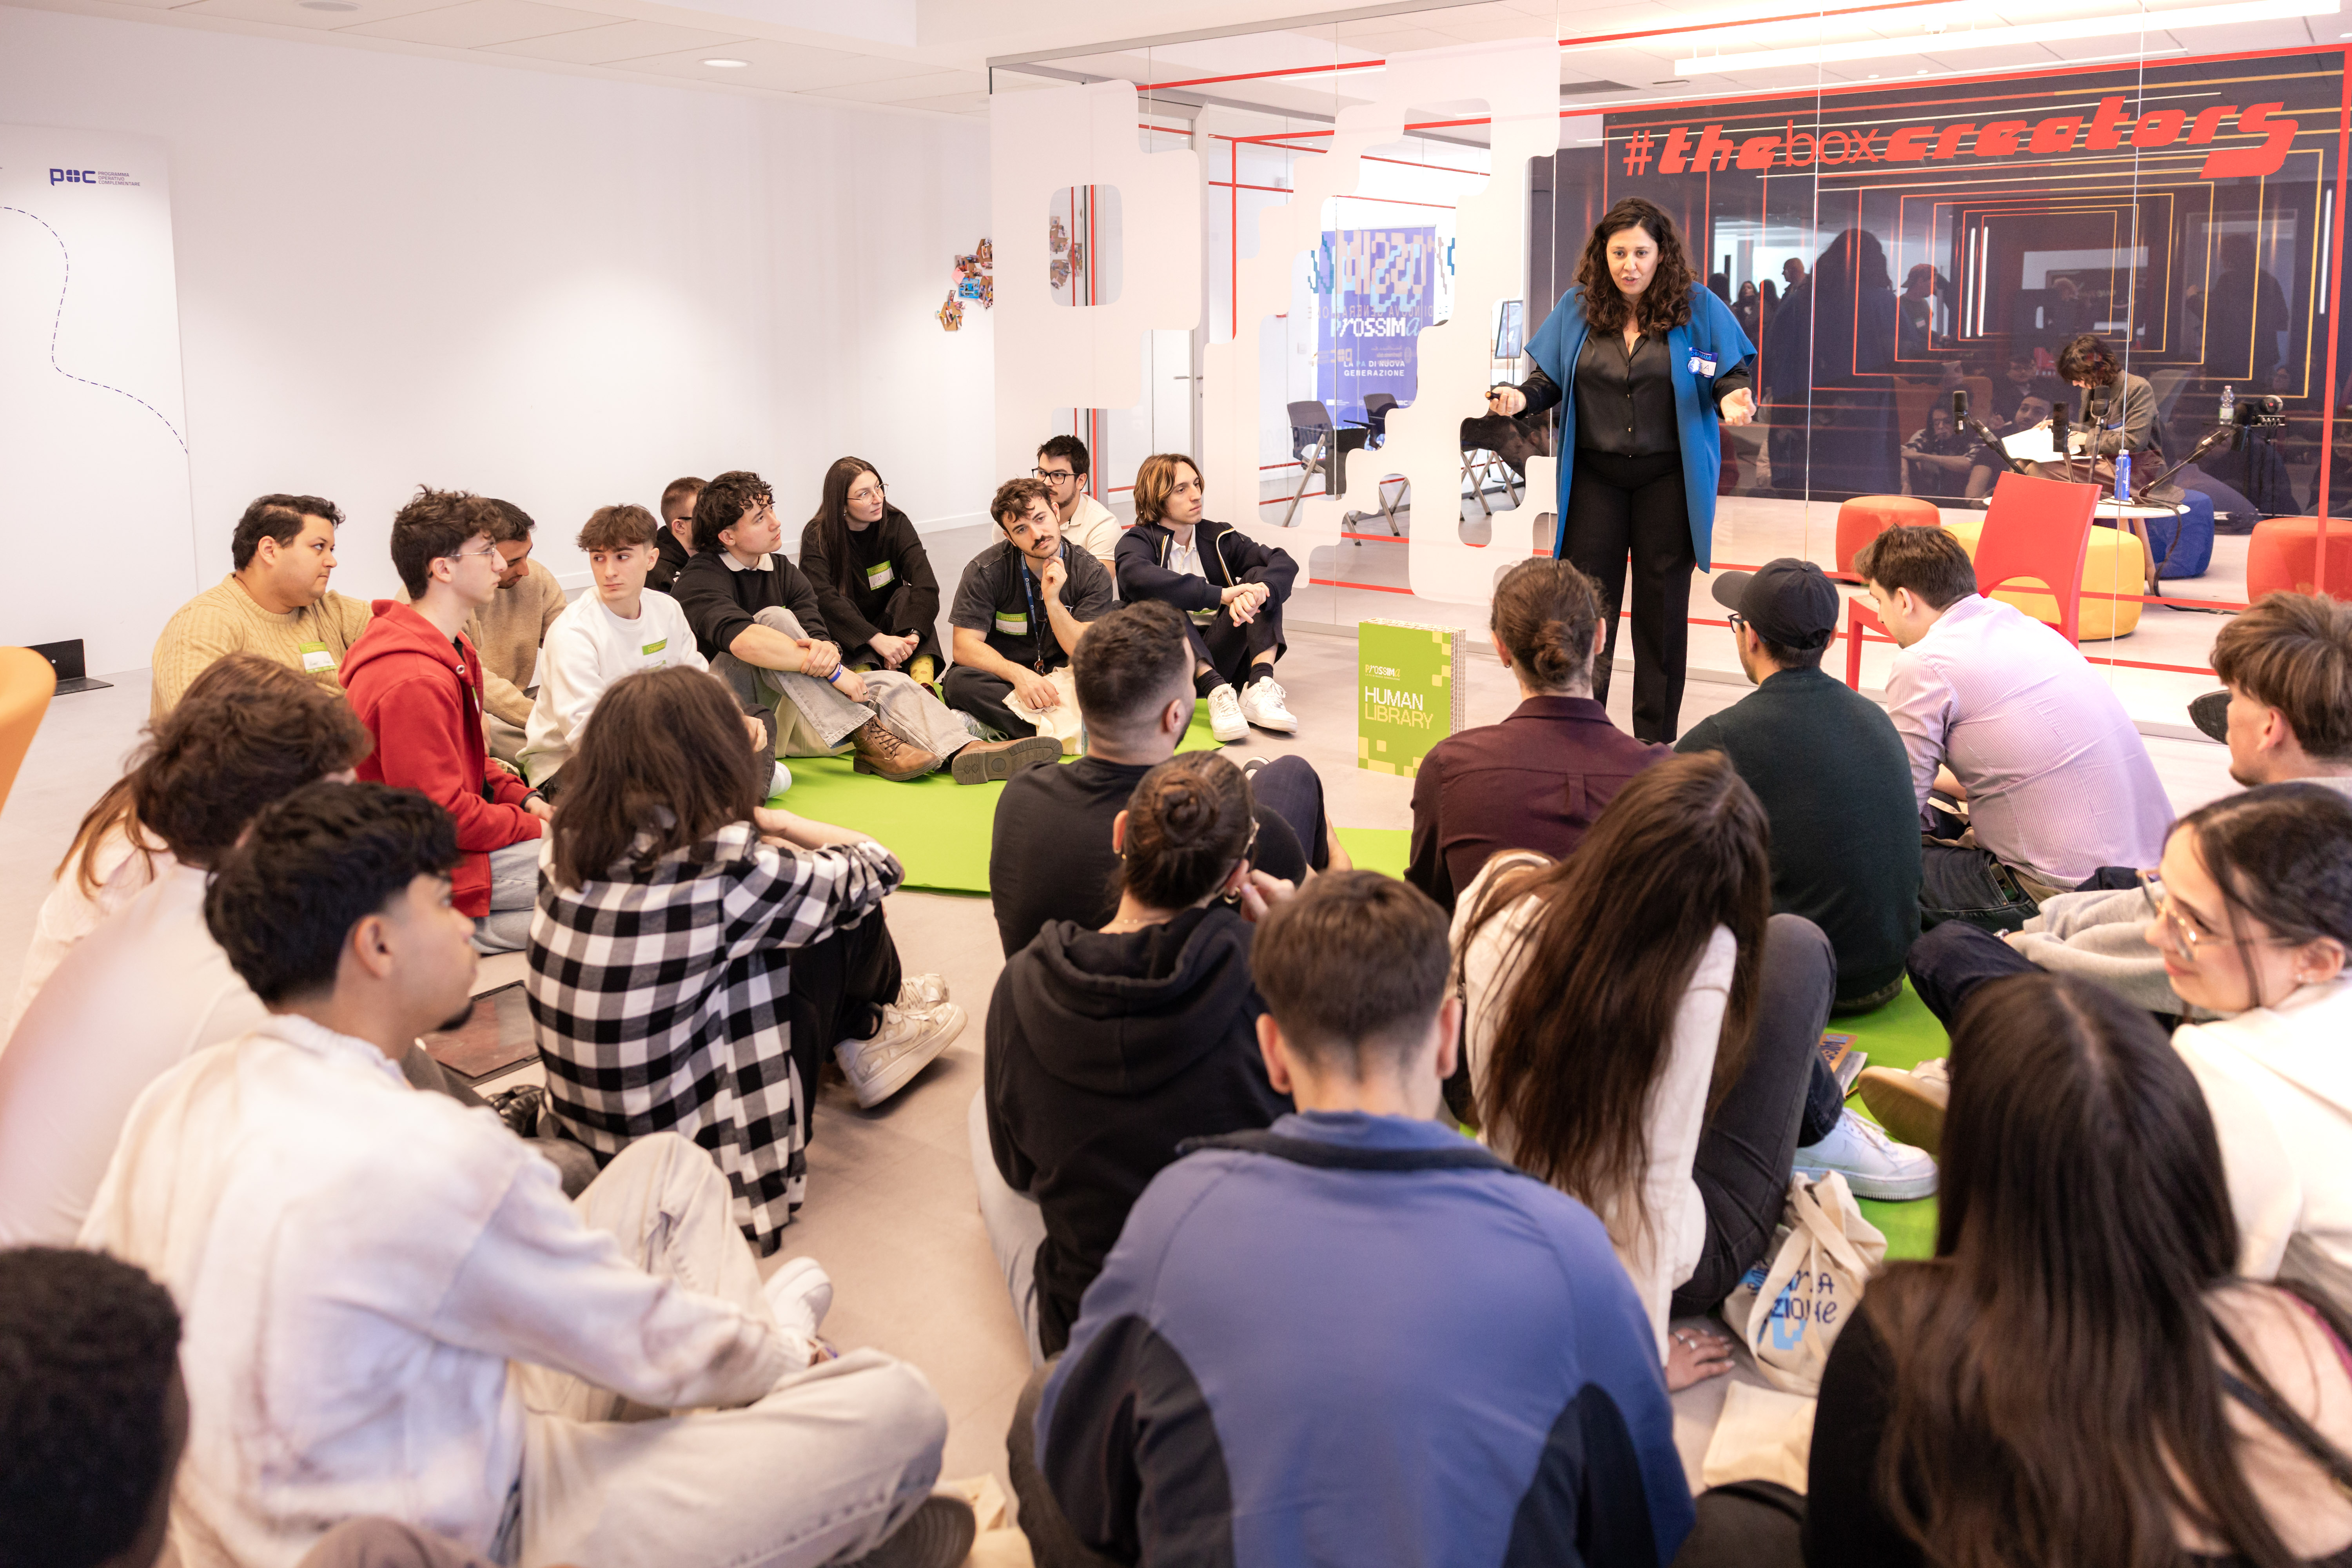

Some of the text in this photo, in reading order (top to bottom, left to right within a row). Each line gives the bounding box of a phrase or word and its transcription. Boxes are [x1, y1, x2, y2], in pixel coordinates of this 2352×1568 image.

[1623, 96, 2299, 179] #theboxcreators
[1365, 686, 1423, 710] HUMAN
[1365, 703, 1433, 730] LIBRARY
